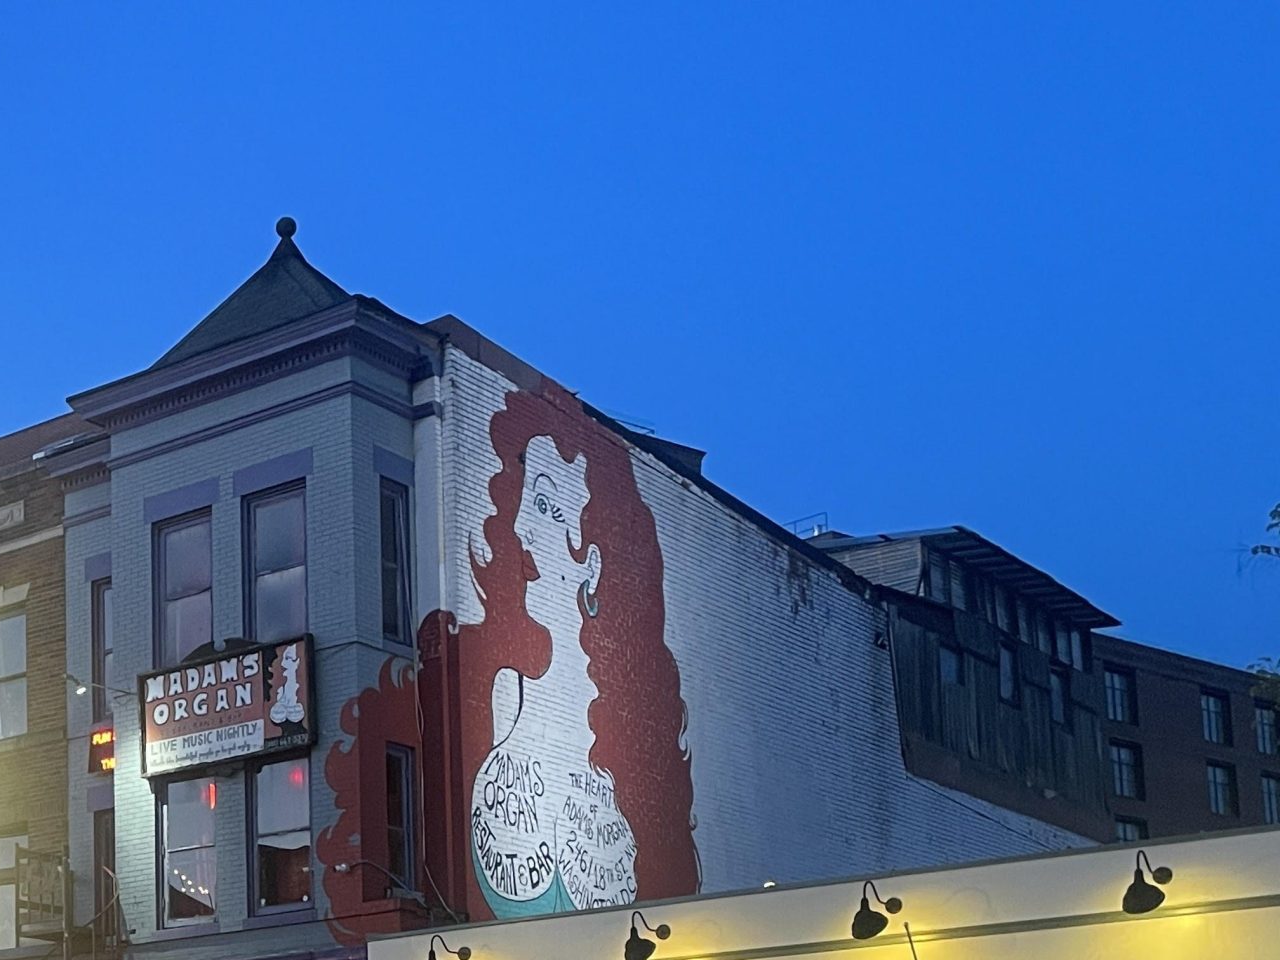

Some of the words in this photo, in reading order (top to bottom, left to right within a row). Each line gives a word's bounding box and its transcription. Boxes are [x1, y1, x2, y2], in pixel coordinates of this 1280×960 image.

[145, 652, 259, 703] MADAM'S
[153, 682, 253, 725] ORGAN
[151, 740, 177, 755] LIVE
[182, 731, 213, 749] MUSIC
[216, 722, 258, 742] NIGHTLY
[485, 751, 545, 797] MADAM'S
[584, 772, 615, 809] HEART
[484, 781, 540, 833] ORGAN
[472, 806, 518, 896] RESTAURANT
[527, 841, 554, 889] BAR
[566, 830, 594, 878] 2461
[619, 876, 637, 905] DC
